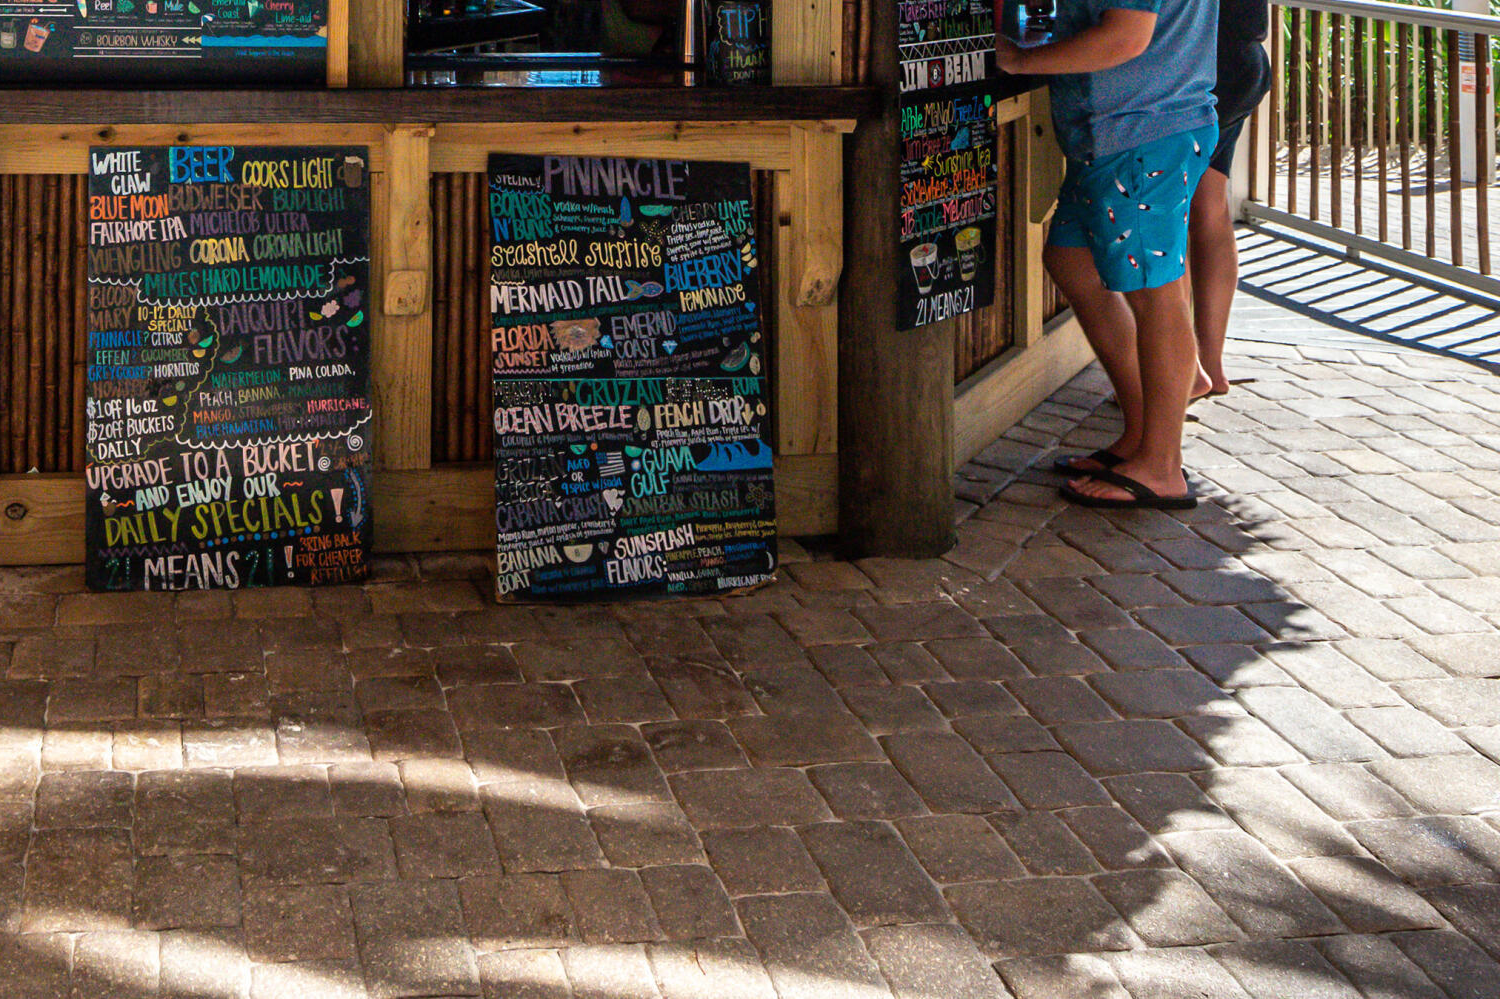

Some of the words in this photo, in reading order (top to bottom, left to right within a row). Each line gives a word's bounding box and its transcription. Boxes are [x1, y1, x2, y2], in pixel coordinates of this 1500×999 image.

[217, 8, 240, 19] Coast
[264, 0, 295, 15] Cherry
[96, 34, 139, 47] BOURBON
[900, 60, 928, 92] JIM
[945, 52, 985, 86] BEAM
[92, 151, 142, 176] WHITE
[169, 146, 235, 185] BEER
[242, 160, 289, 189] COORS
[934, 149, 973, 177] Sunshine
[974, 145, 991, 172] Tea
[111, 173, 151, 195] CLAW
[90, 195, 129, 220] BLUE
[131, 193, 170, 220] MOON
[169, 184, 264, 213] BUDWEISER
[490, 193, 552, 220] BOARDS
[91, 220, 157, 246] FAIRHOPE
[160, 216, 188, 242] IPA
[190, 211, 261, 236] MICHELOB
[265, 212, 310, 234] ULTRA
[512, 219, 553, 241] BUNS
[725, 218, 746, 238] AID
[189, 236, 250, 265] CORONA
[145, 270, 199, 298] MIKES
[202, 267, 241, 294] HARD
[243, 264, 326, 292] LEMONADE
[491, 280, 583, 314] MERMAID
[585, 276, 629, 305] TAIL
[915, 298, 927, 327] 21
[928, 289, 962, 323] MEANS
[963, 285, 974, 314] 21
[168, 306, 197, 320] DAILY
[151, 331, 183, 346] CITRUS
[254, 324, 349, 365] FLAVORS
[491, 323, 555, 352] FLORIDA
[616, 338, 657, 359] COAST
[154, 362, 200, 378] HORNITOS
[289, 366, 313, 381] PINA
[494, 351, 548, 369] SUNSET
[576, 379, 663, 407] CRUZAN
[733, 377, 760, 396] RUM
[494, 403, 554, 435] OCEAN
[555, 402, 633, 432] BREEZE
[654, 400, 706, 429] PEACH
[708, 395, 745, 426] DROP
[127, 415, 174, 438] BUCKETS
[98, 437, 141, 460] DAILY
[642, 446, 697, 473] GUAVA
[87, 456, 173, 491] UPGRADE
[181, 452, 209, 481] TO
[216, 449, 231, 479] A
[243, 440, 315, 477] BUCKET
[571, 472, 584, 482] OR
[135, 486, 170, 511] AND
[176, 476, 232, 509] ENJOY
[243, 473, 282, 499] OUR
[631, 472, 670, 498] GULF
[104, 506, 181, 548] DAILY
[614, 523, 695, 560] SUNSPLASH
[144, 551, 240, 591] MEANS
[497, 545, 563, 574] BANANA
[497, 569, 531, 594] BOAT
